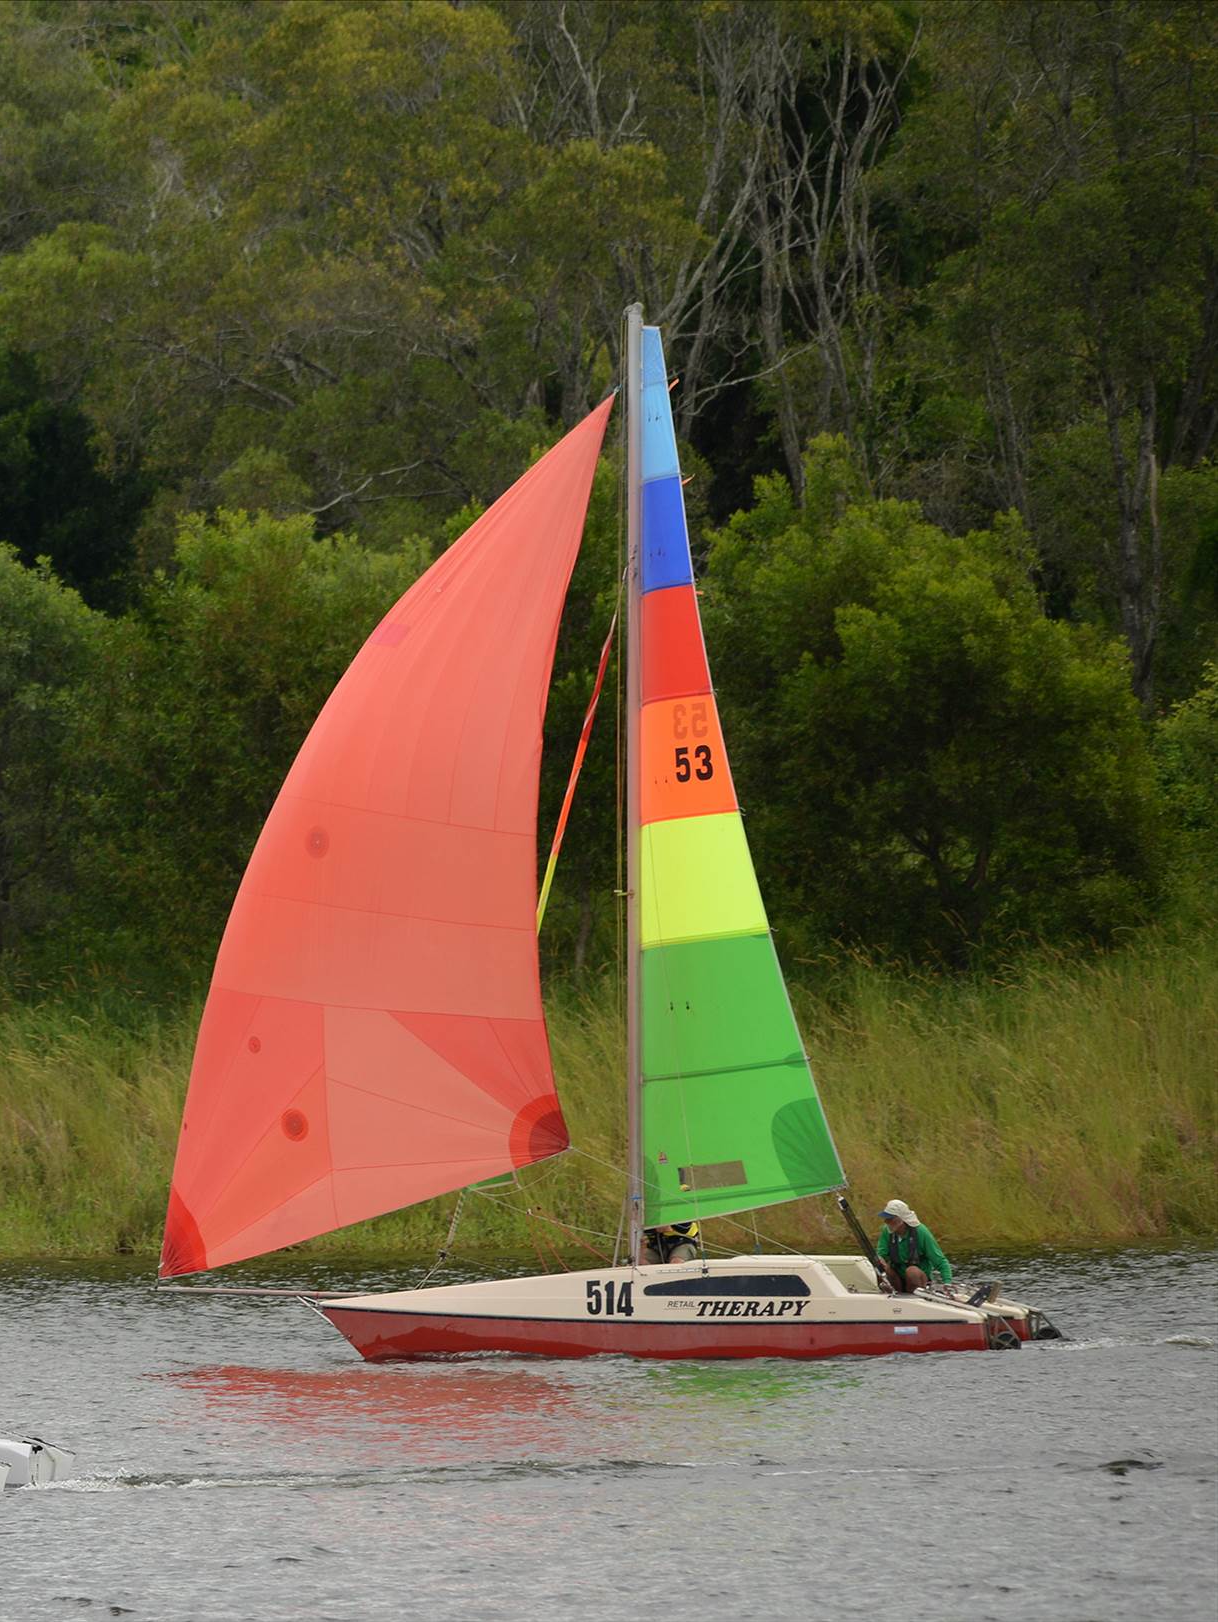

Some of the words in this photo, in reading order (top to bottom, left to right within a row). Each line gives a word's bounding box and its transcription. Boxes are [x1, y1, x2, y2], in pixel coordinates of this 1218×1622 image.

[675, 745, 713, 782] 53
[586, 1280, 634, 1317] 514
[667, 1300, 695, 1308] RETAIL
[696, 1300, 810, 1317] THERAPY
